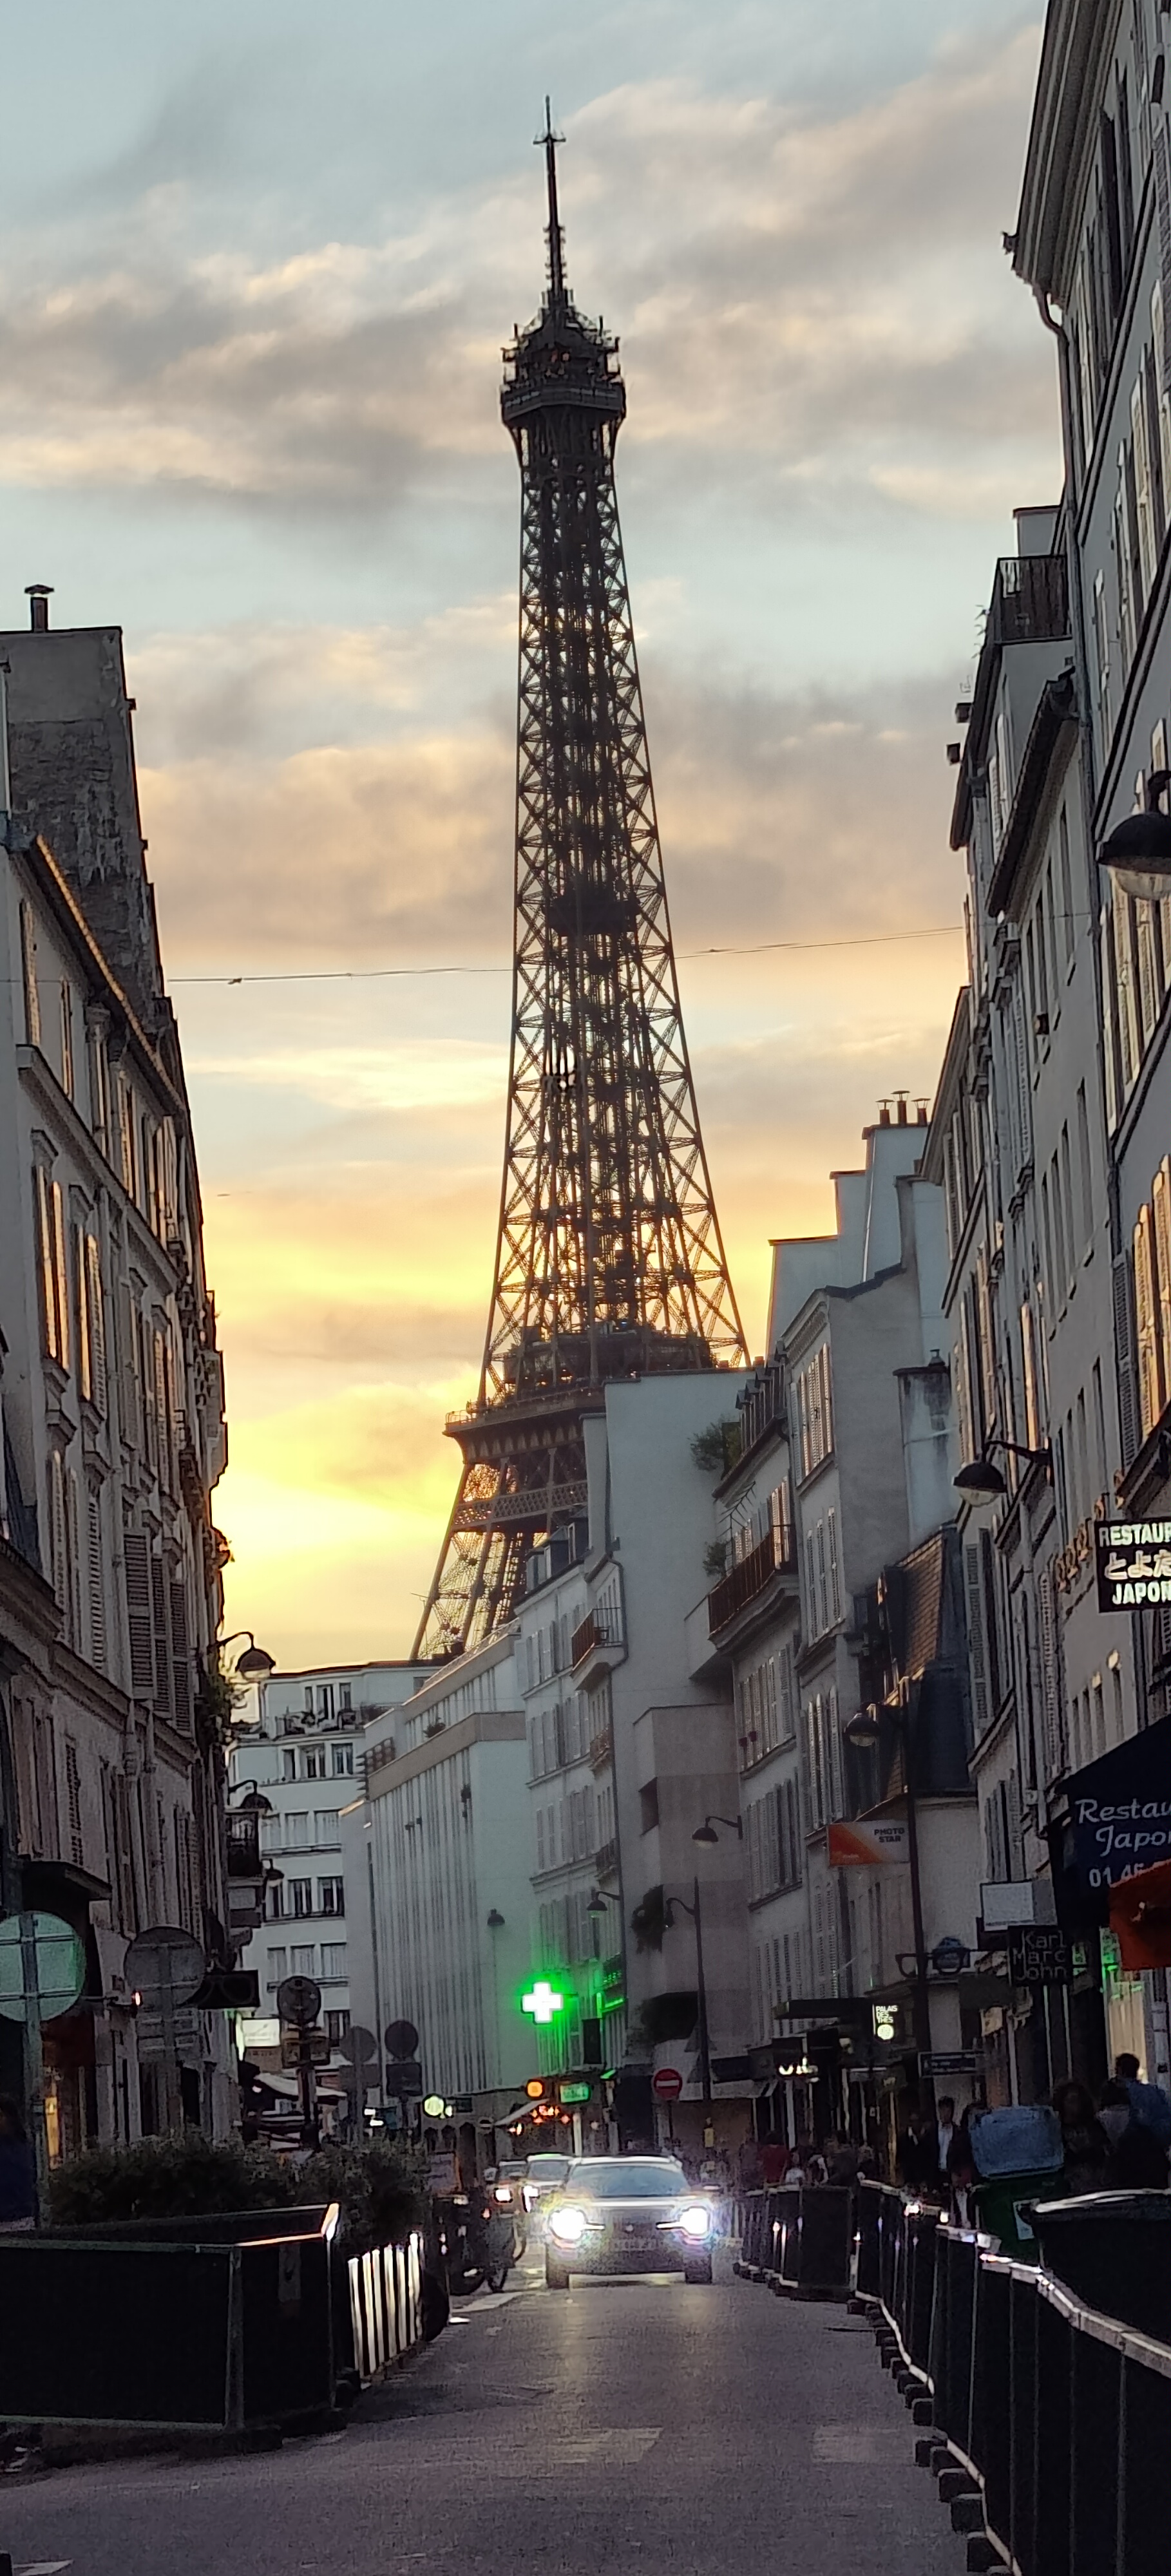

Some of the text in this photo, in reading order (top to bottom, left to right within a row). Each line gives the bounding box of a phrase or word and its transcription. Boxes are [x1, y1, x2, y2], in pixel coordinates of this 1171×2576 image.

[1112, 1580, 1171, 1604] JAPON
[1095, 1824, 1171, 1857] Japo
[1022, 1929, 1067, 1949] Karl
[1012, 1947, 1065, 1965] Marc
[1016, 1962, 1067, 1981] John
